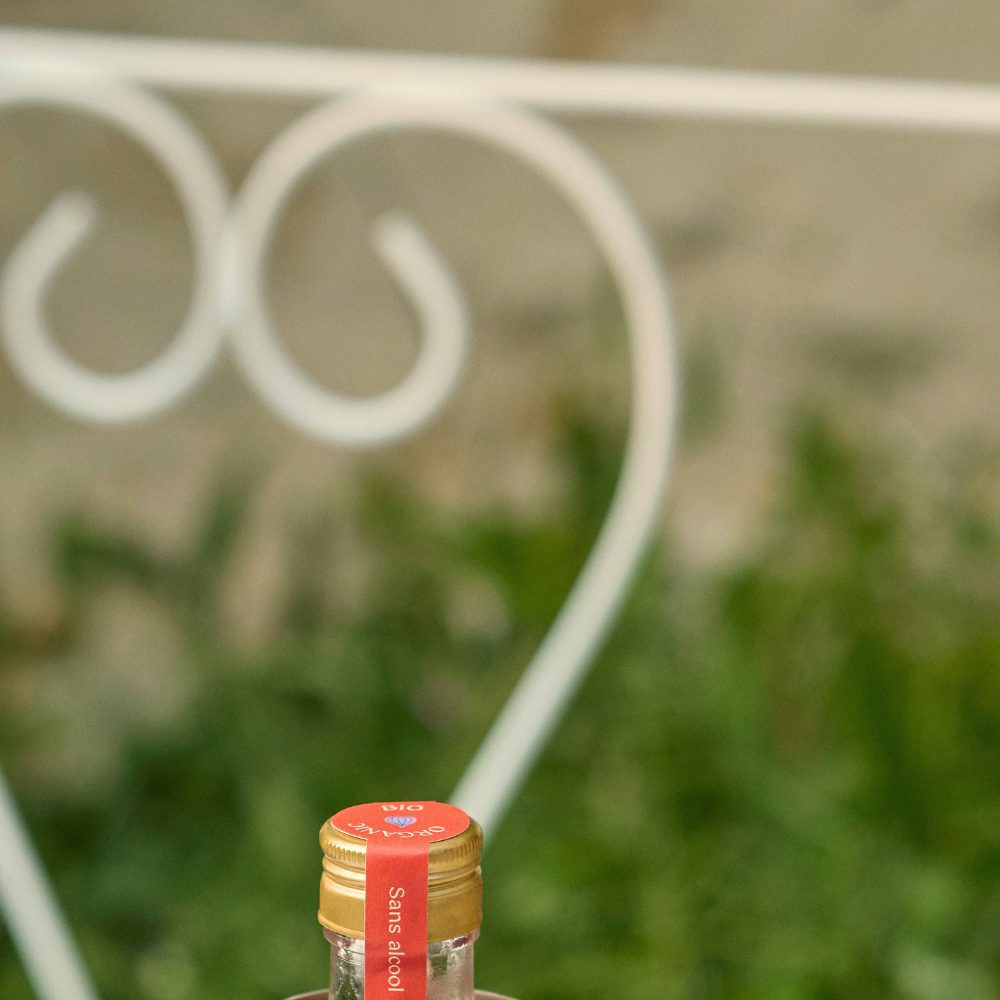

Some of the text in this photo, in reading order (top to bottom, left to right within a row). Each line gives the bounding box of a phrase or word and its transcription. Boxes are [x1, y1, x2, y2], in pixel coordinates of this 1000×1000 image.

[381, 804, 424, 812] BIO
[347, 822, 445, 838] ORGANIC
[387, 886, 405, 992] Sans alcool
